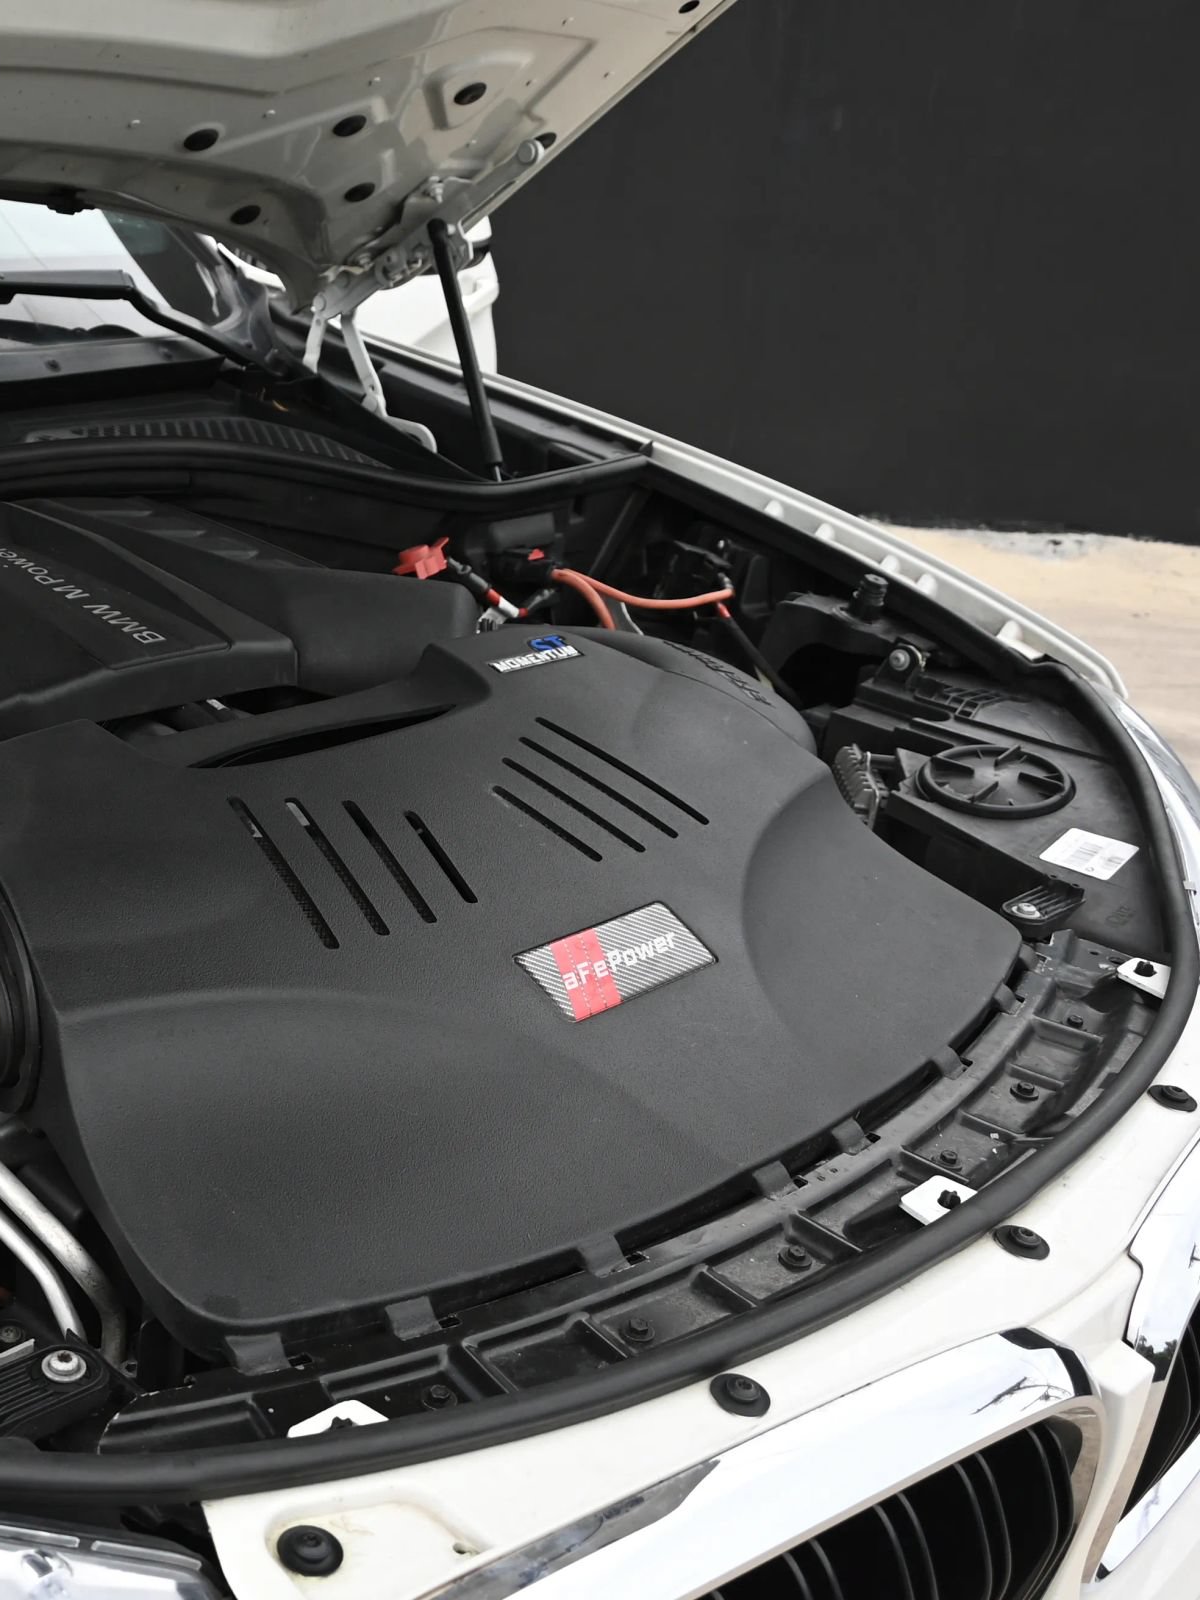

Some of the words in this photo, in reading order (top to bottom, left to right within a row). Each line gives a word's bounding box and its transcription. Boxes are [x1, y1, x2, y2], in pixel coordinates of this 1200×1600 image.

[83, 604, 166, 644] BMW
[530, 633, 564, 652] ST
[492, 645, 579, 673] MOMENTUM
